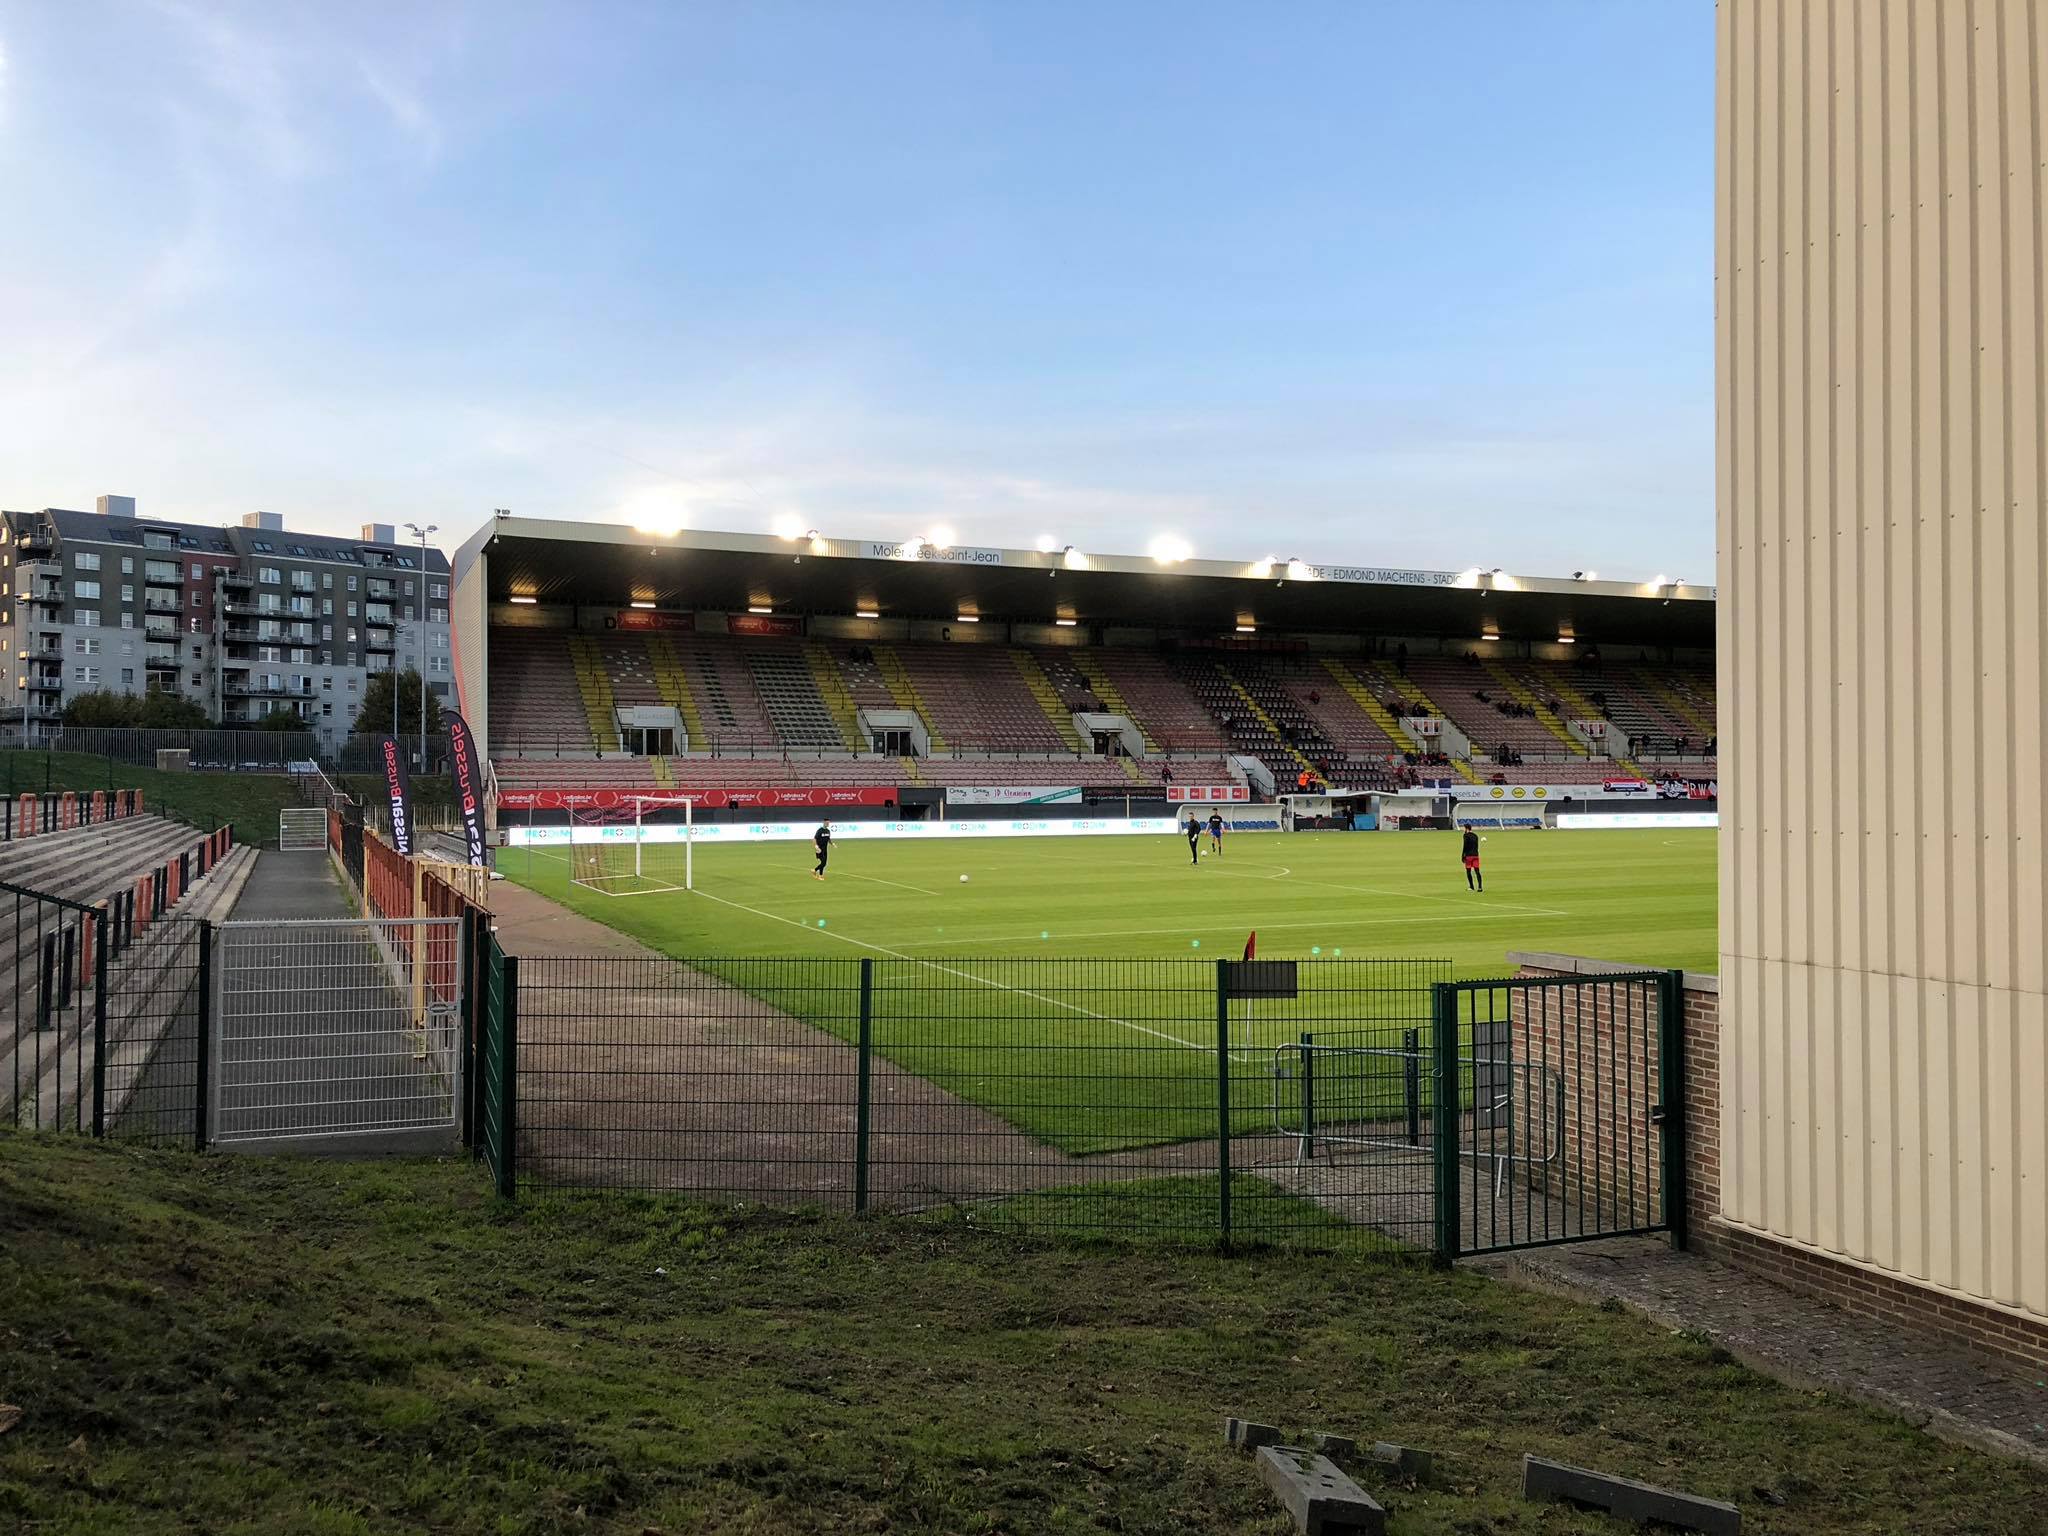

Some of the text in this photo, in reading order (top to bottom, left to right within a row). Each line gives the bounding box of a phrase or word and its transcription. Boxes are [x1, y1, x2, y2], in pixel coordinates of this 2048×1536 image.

[873, 544, 1000, 563] Moleeek-Saint-Jean
[1333, 569, 1375, 581] EDMOND
[1377, 571, 1425, 583] MACHTENS
[942, 628, 950, 641] C
